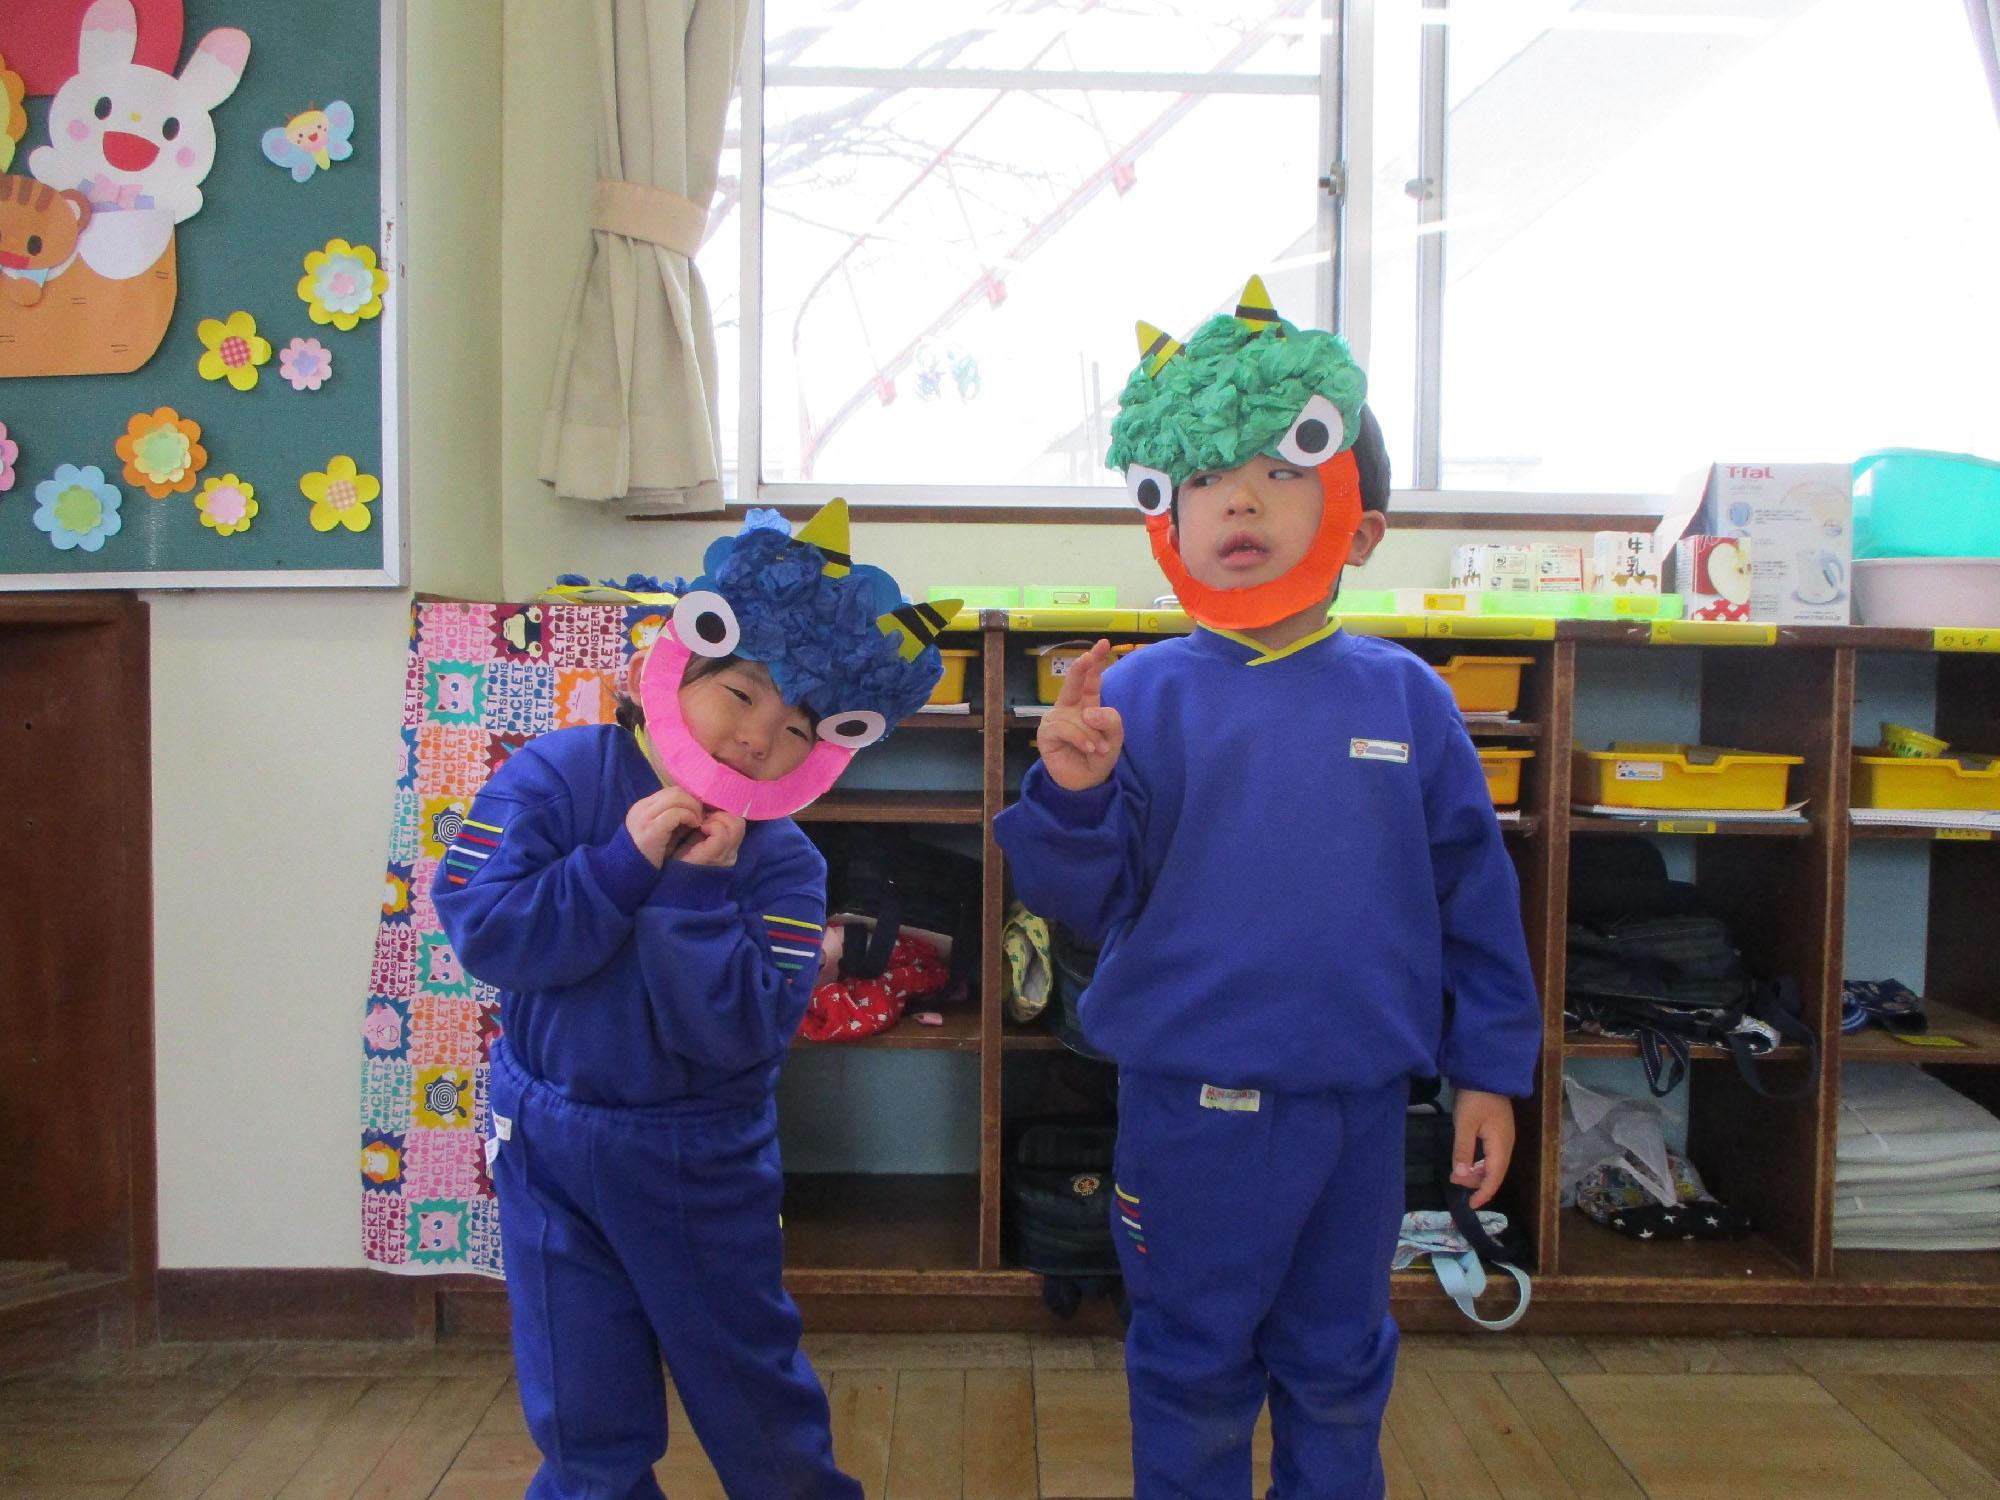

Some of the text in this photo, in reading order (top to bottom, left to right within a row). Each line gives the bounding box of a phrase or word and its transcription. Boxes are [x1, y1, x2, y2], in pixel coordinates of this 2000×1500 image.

[1626, 536, 1646, 577] 牛乳
[403, 656, 417, 727] KETPOC
[485, 662, 499, 730] KETPOC
[497, 662, 509, 730] TERSMONS
[507, 664, 523, 732] POCKET
[522, 665, 533, 733] MONSTERS
[533, 666, 548, 734] KETPOC
[432, 726, 442, 793] TERSMONS
[441, 727, 457, 796] POCKET
[456, 728, 467, 797] MONSTERS
[376, 927, 391, 994] POCKET
[388, 928, 397, 996] MONSTERS
[396, 928, 410, 997] KETPOC
[424, 996, 434, 1065] TERSMONS
[434, 997, 449, 1065] POCKET
[449, 999, 458, 1065] MONSTERS
[458, 1000, 471, 1066] KETPOC
[369, 1062, 384, 1129] POCKET
[391, 1064, 405, 1132] KETPOC
[474, 1067, 484, 1134] KETPOC
[366, 1193, 378, 1261] POCKET
[378, 1196, 386, 1263] MONSTERS
[386, 1198, 400, 1265] KETPOC
[471, 1199, 481, 1266] KETPOC
[481, 1199, 490, 1266] TERSMONS
[489, 1201, 501, 1271] POCKET
